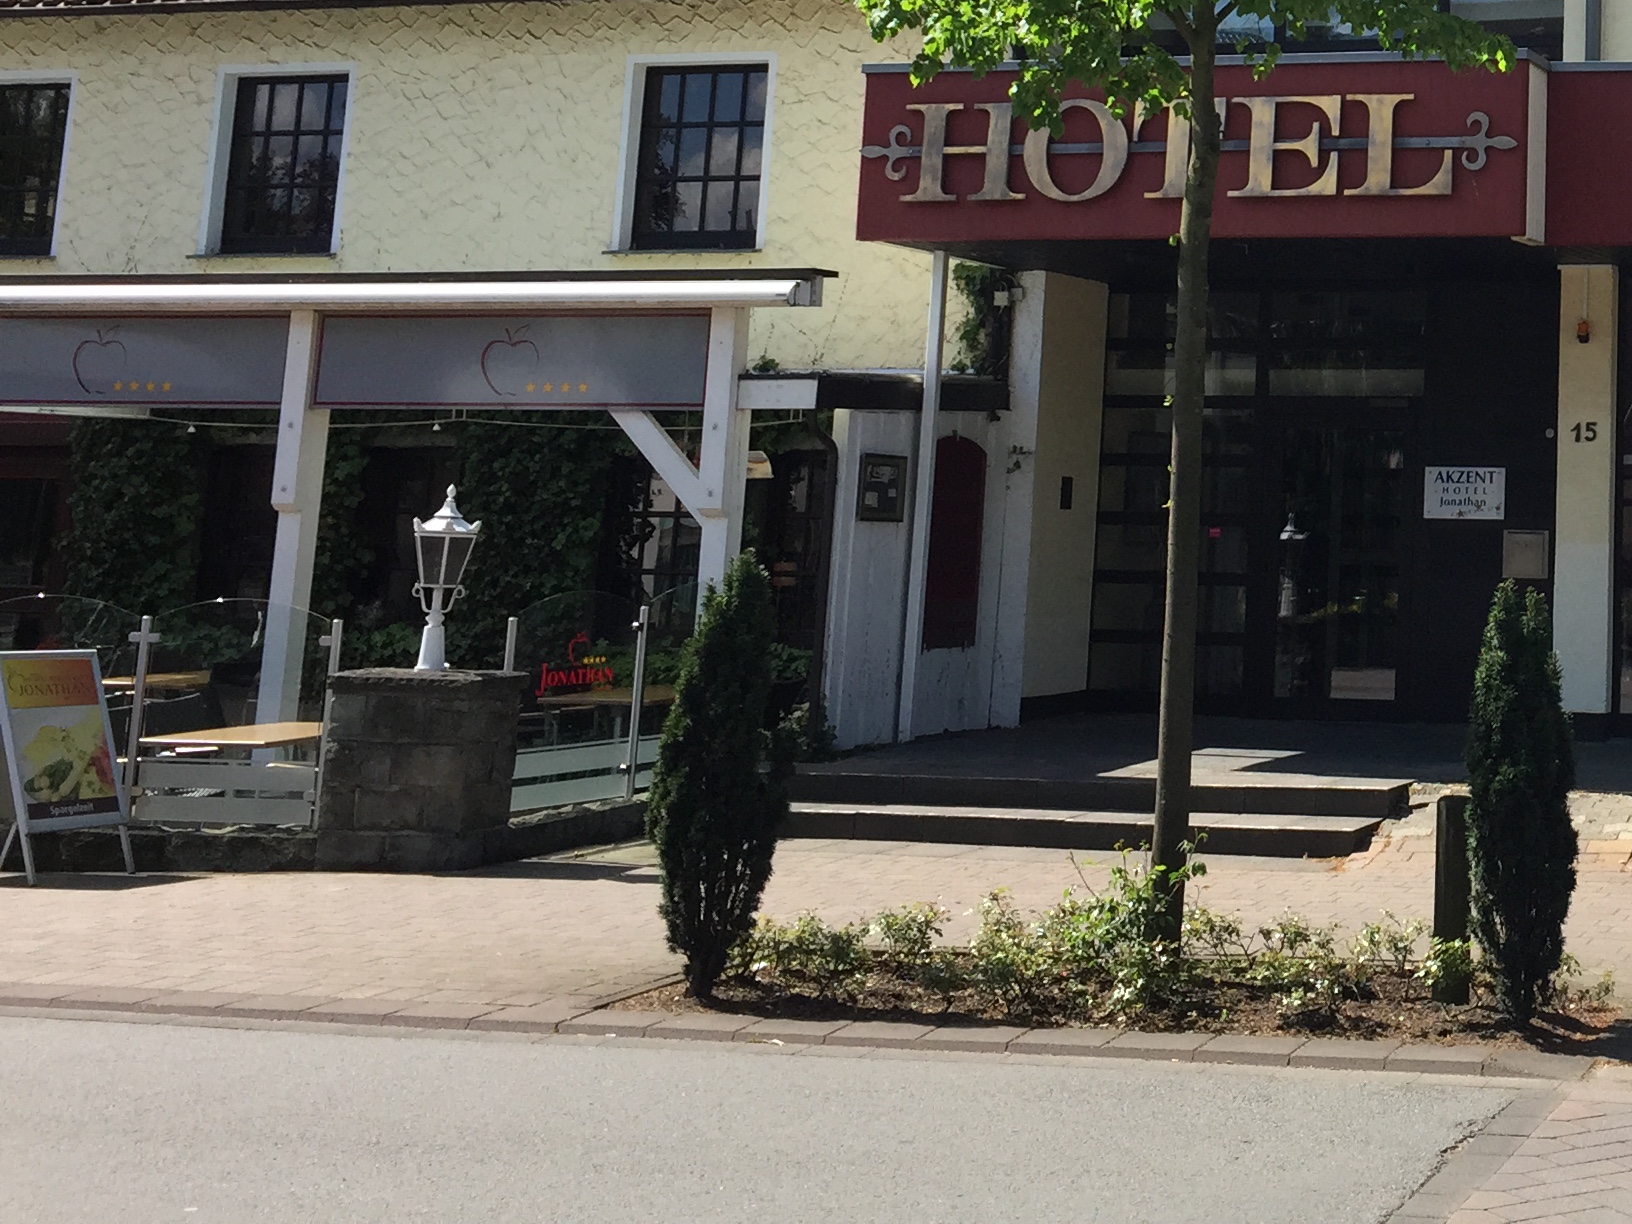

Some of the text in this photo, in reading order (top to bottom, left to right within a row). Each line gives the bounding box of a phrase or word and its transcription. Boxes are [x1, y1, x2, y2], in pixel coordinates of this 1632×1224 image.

[899, 93, 1454, 202] HOTEL
[1569, 421, 1598, 443] 15
[1434, 470, 1497, 485] AKZENT
[1441, 486, 1488, 496] HOTEL
[1439, 496, 1487, 508] Jonathan
[19, 681, 92, 697] JONATHAN
